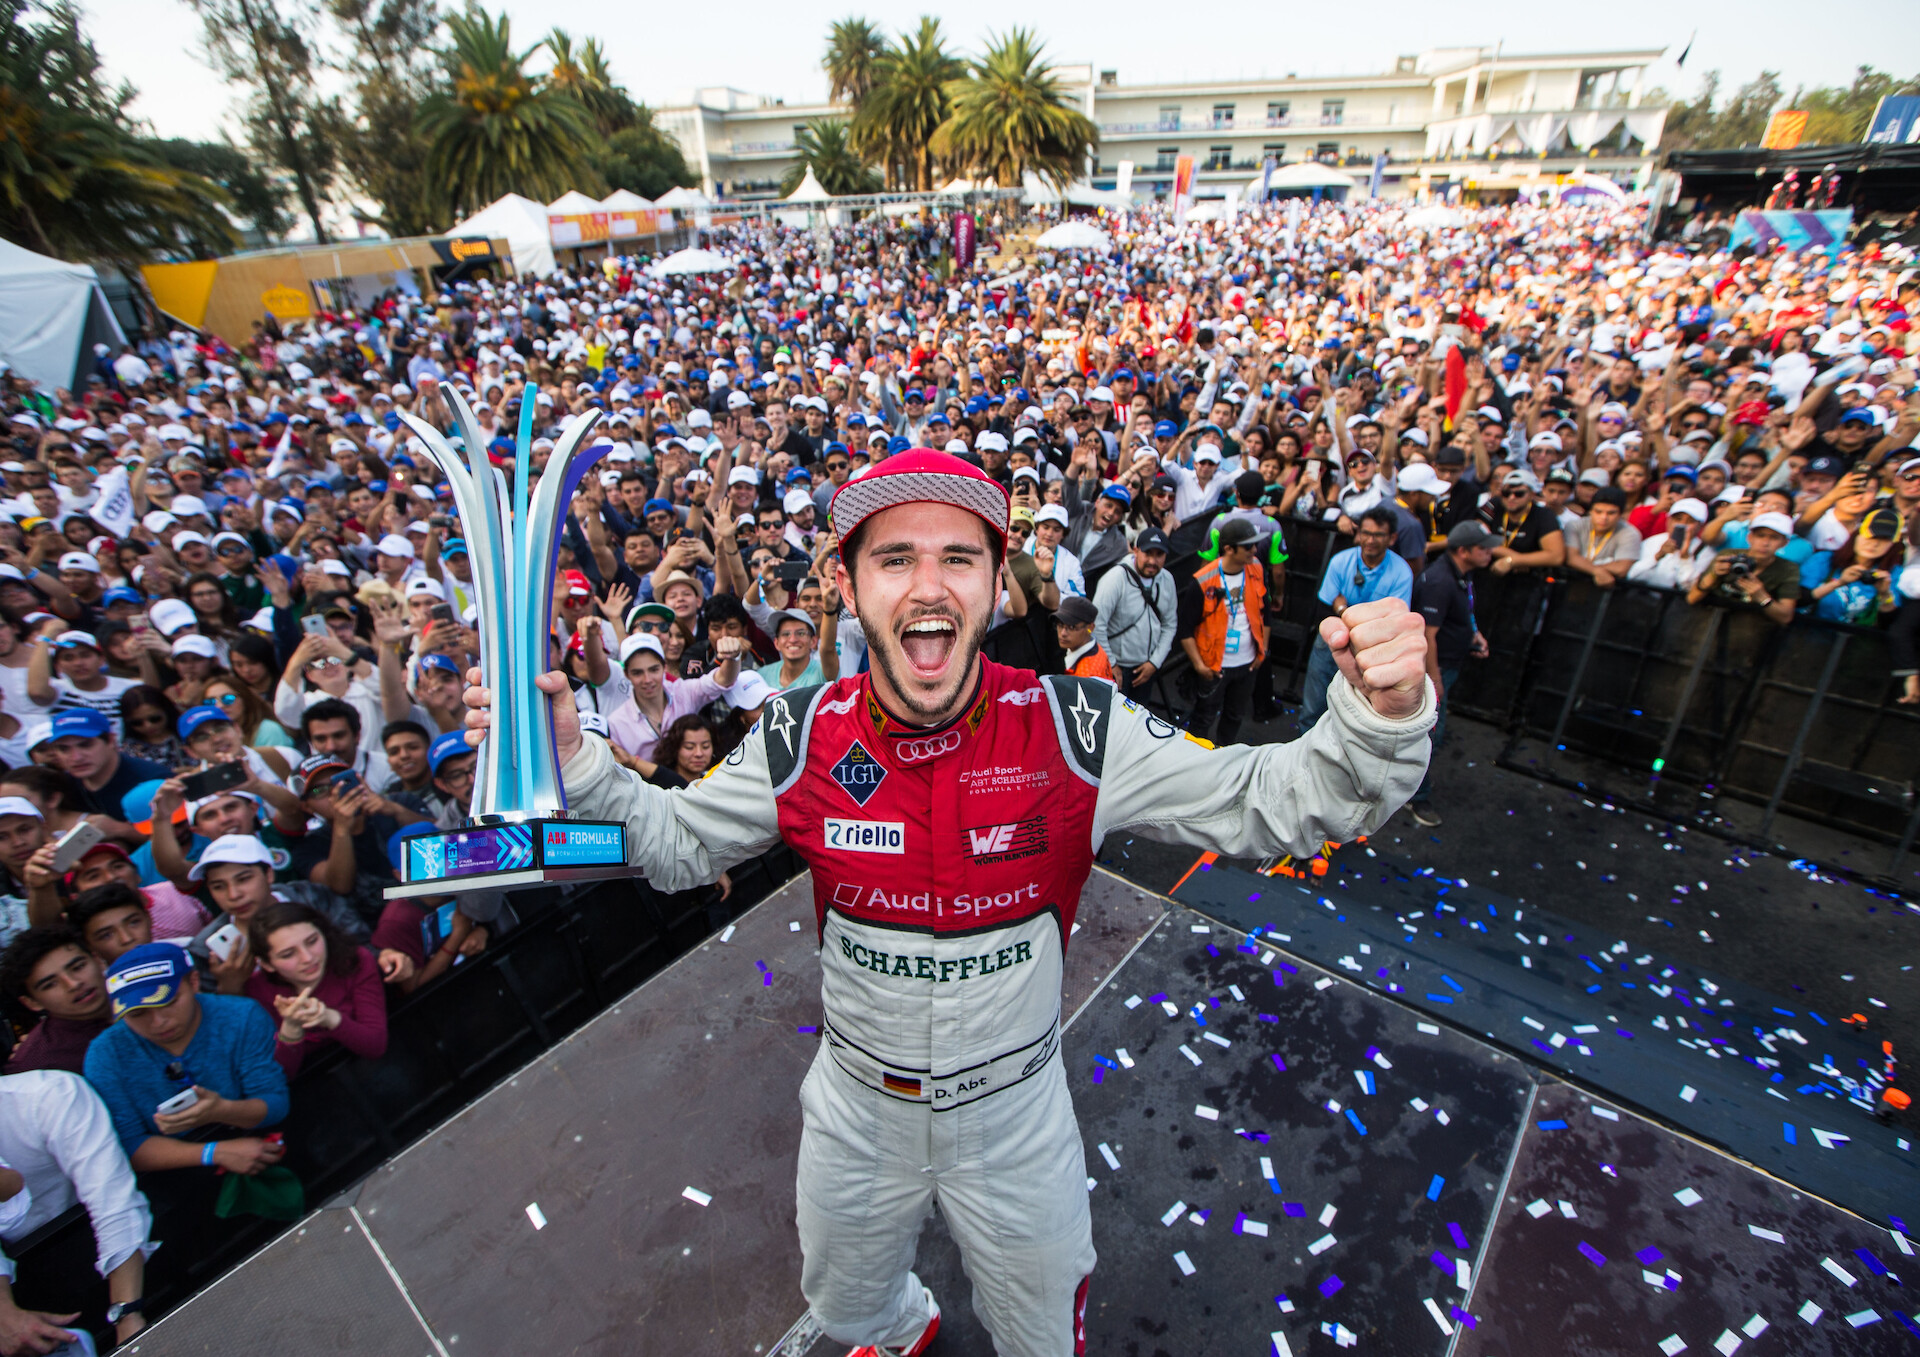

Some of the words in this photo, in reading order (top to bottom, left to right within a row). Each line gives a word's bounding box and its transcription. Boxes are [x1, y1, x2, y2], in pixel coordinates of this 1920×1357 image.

[838, 764, 879, 785] LGT
[970, 767, 992, 778] Audi
[994, 766, 1022, 776] Sport
[970, 778, 990, 788] ABT
[992, 770, 1049, 785] SCHAEFFLER
[970, 786, 1012, 796] FORMULA
[1026, 780, 1050, 789] TEAM
[547, 832, 566, 844] ABB
[968, 823, 1018, 856] WE
[448, 842, 458, 869] MEX
[974, 854, 1004, 866] WÜRTH
[1004, 846, 1049, 862] ELEKTRONIK
[866, 888, 944, 916] Audi
[953, 882, 1040, 916] Sport
[841, 936, 1032, 982] SCHAEFFLER
[934, 1089, 952, 1099] D.
[957, 1076, 988, 1094] Abt
